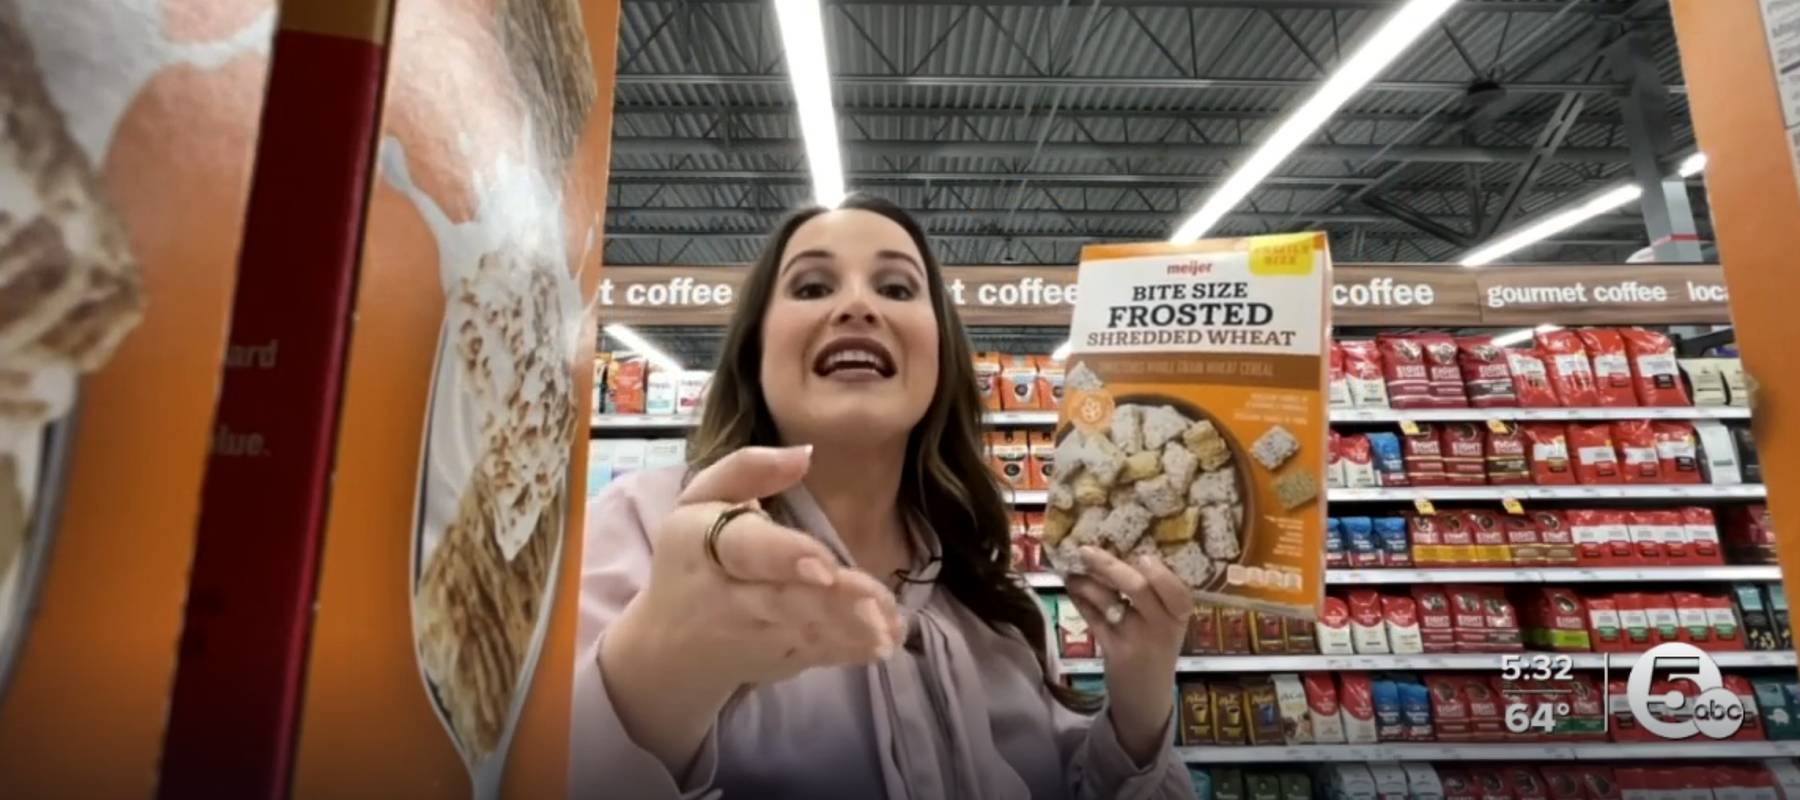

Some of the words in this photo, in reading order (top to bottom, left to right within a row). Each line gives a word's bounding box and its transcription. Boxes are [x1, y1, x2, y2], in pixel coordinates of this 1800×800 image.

[1166, 261, 1213, 276] meijer
[626, 277, 733, 305] coffee
[978, 277, 1080, 305] coffee
[1132, 284, 1186, 301] BITE
[1192, 282, 1248, 299] SIZE
[1331, 277, 1435, 306] coffee
[1487, 282, 1588, 308] gourmet
[1593, 281, 1667, 302] coffee
[1687, 281, 1729, 302] loc
[1107, 302, 1274, 329] FROSTED
[1086, 329, 1203, 347] SHREDDED
[1207, 330, 1297, 347] WHEAT
